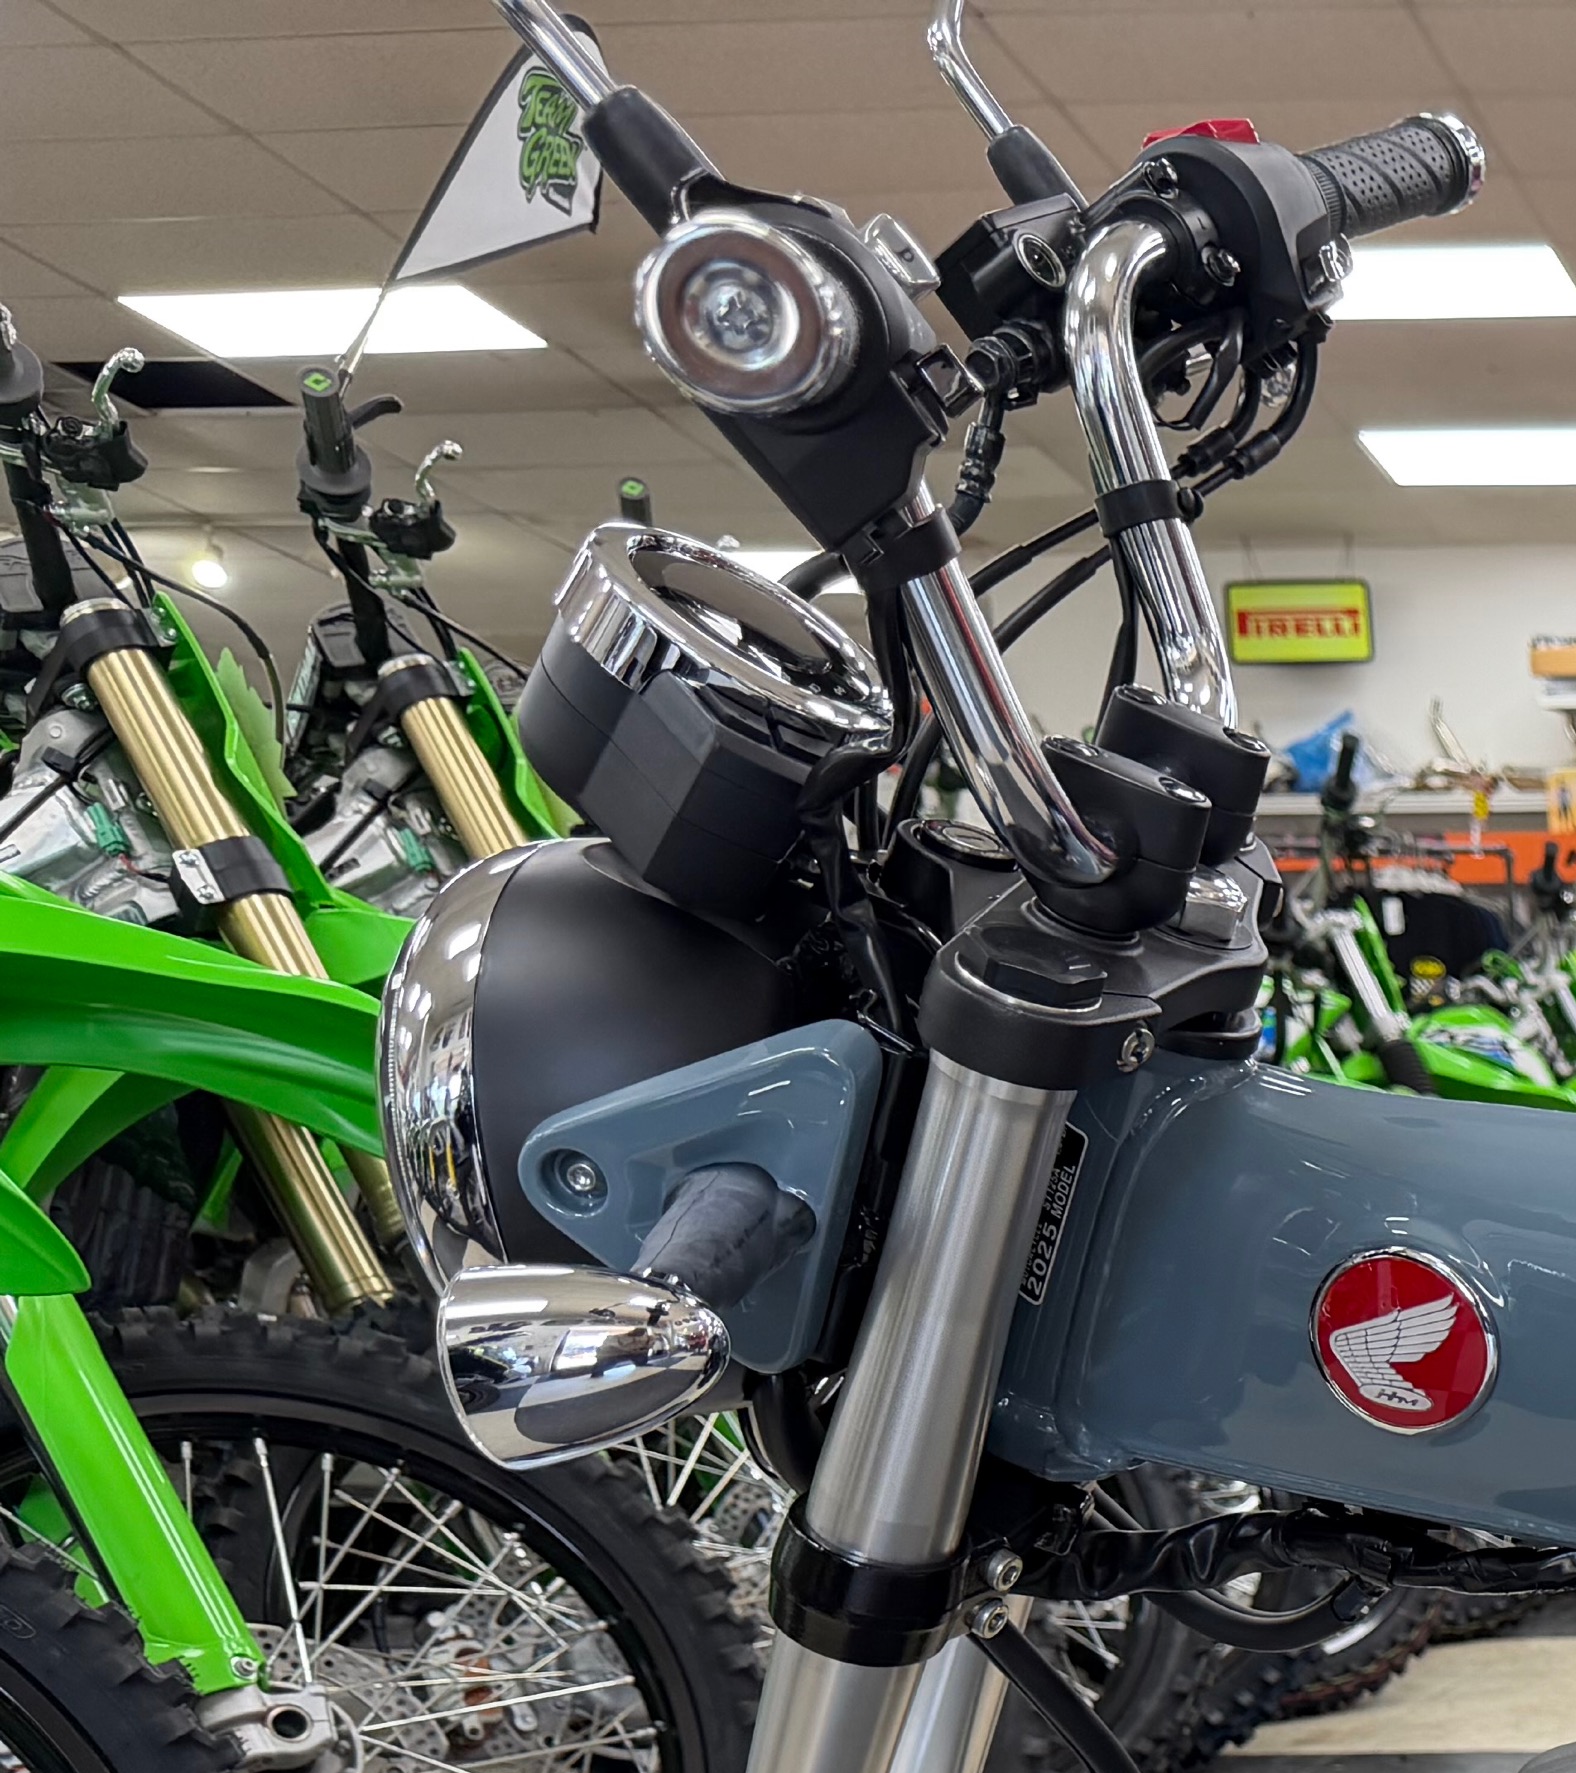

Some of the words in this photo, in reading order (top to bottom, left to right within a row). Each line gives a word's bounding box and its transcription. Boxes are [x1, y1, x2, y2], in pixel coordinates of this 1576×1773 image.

[519, 70, 578, 138] TEAM
[520, 128, 583, 190] GREEN
[1237, 608, 1360, 637] PIRELLI
[1051, 1164, 1076, 1219] MODEL
[1027, 1222, 1058, 1296] 2025
